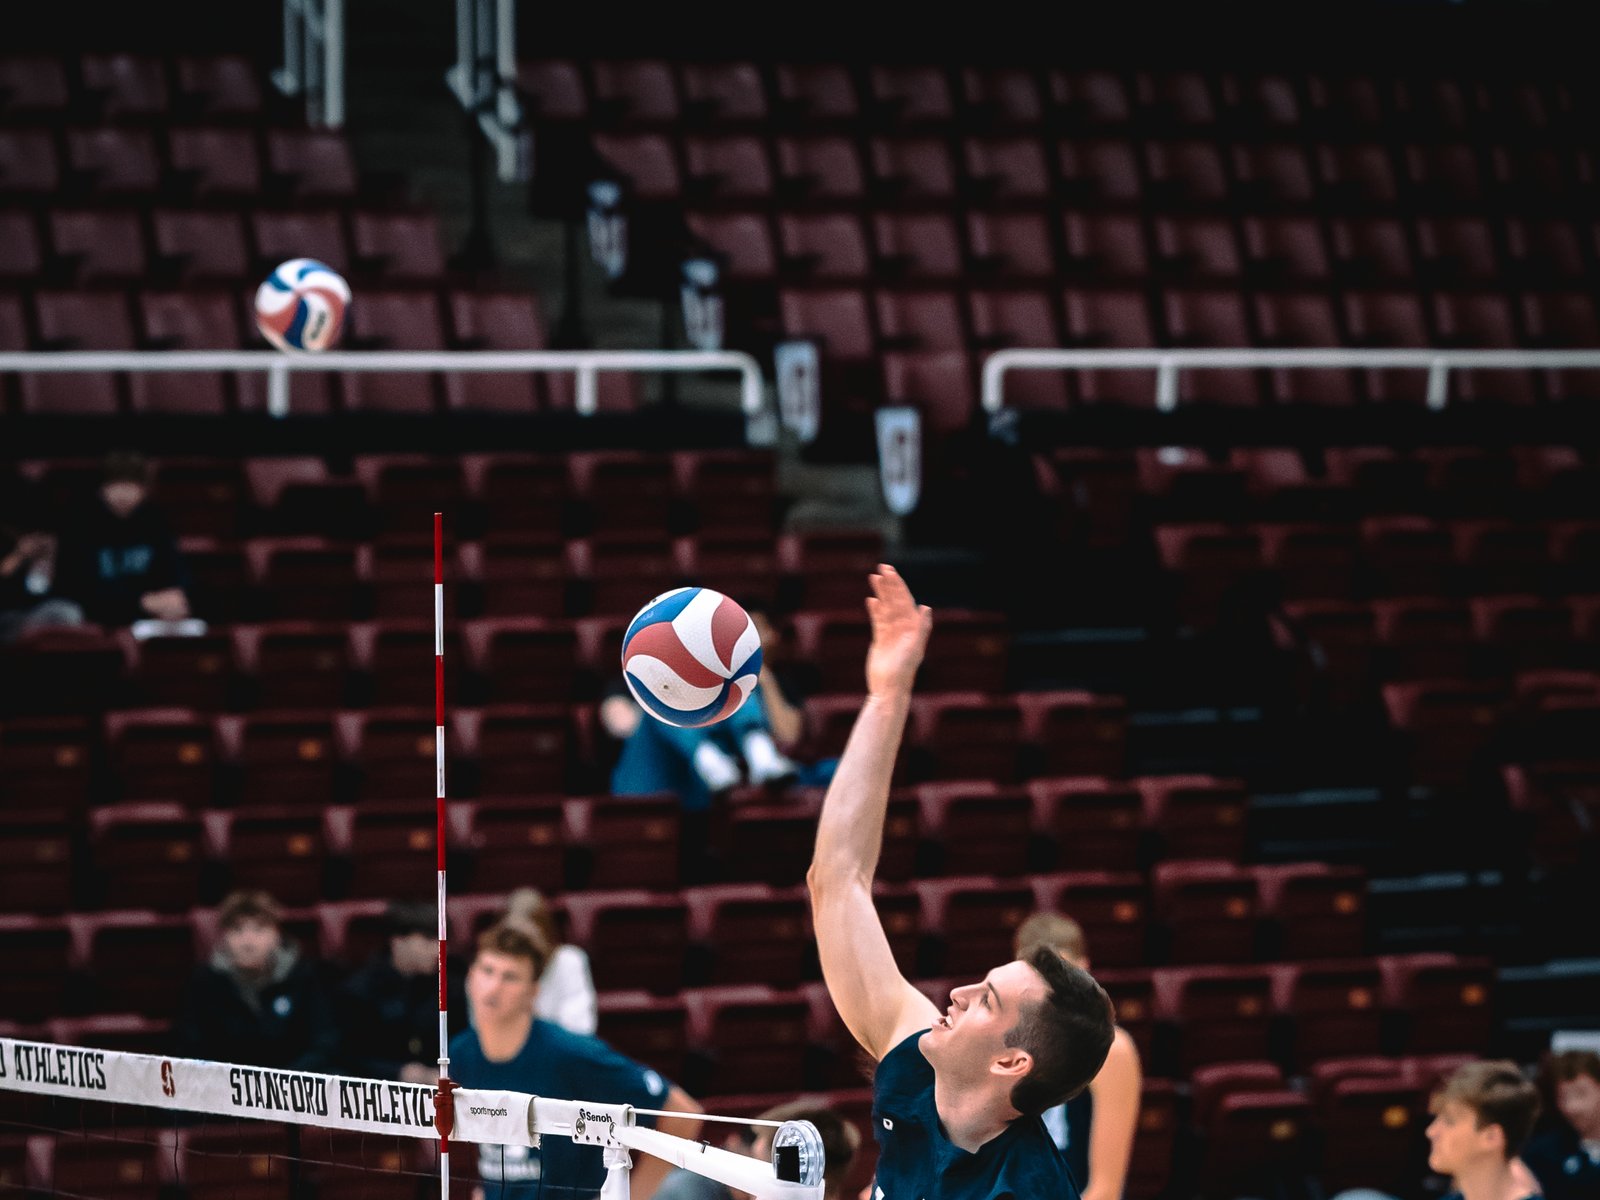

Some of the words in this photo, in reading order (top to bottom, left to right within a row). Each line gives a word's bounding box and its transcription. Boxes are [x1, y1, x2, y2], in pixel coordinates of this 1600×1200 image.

[14, 1044, 107, 1090] ATHLETICS
[229, 1068, 329, 1117] STANFORD
[339, 1080, 438, 1128] ATHLETIC
[586, 1111, 613, 1123] Senoh
